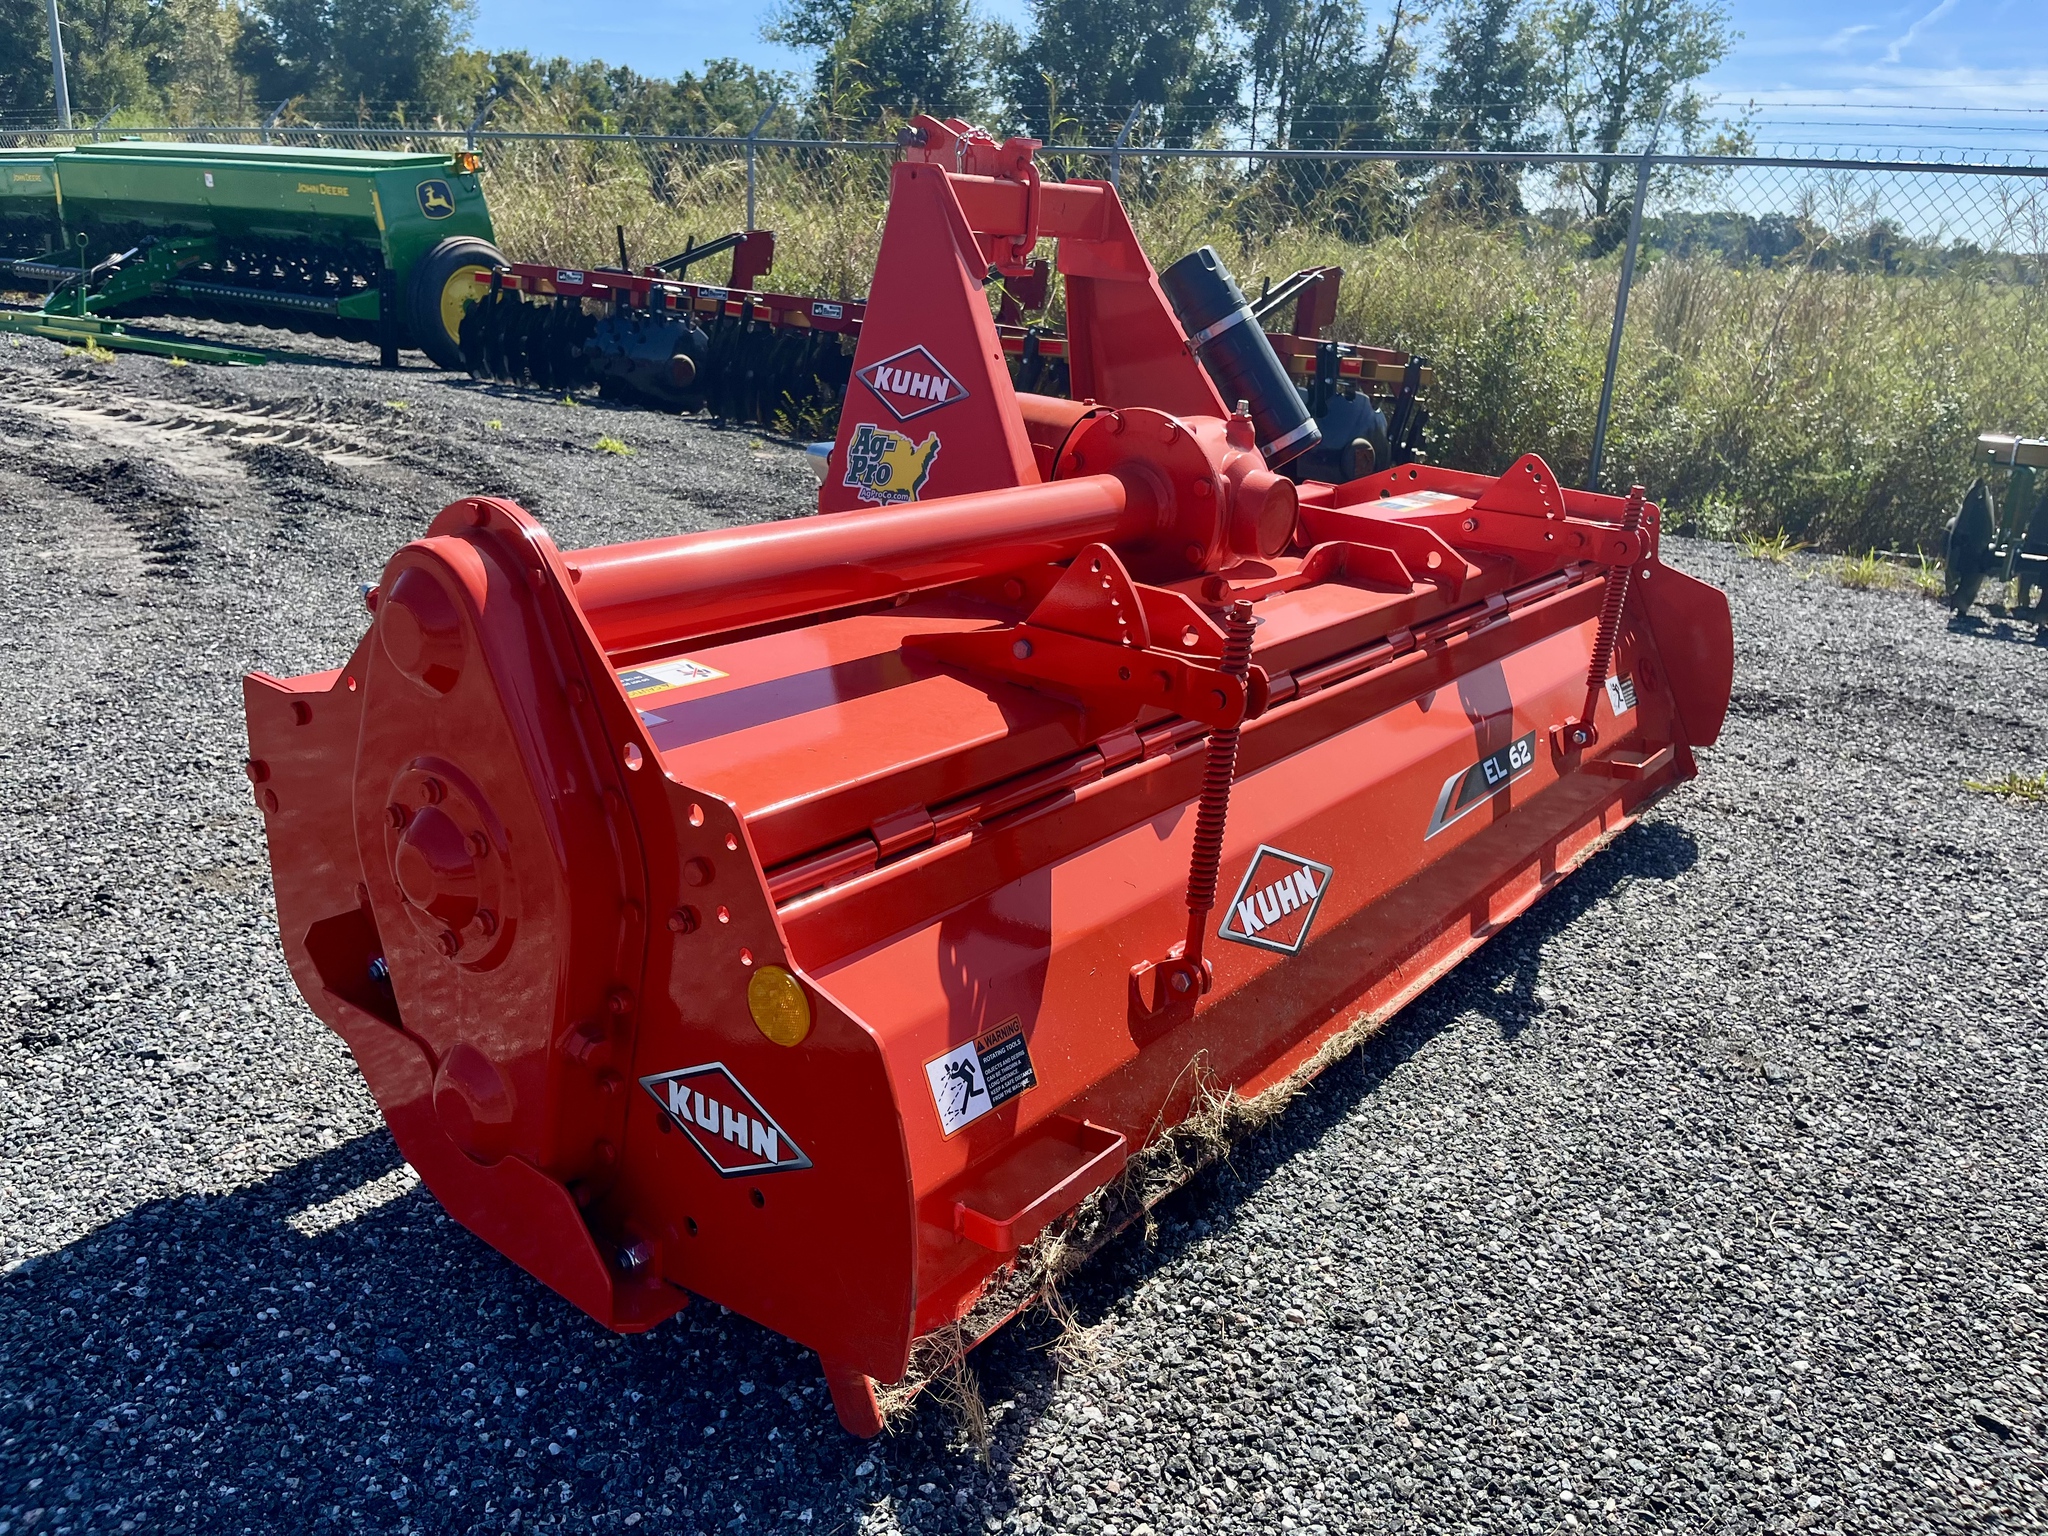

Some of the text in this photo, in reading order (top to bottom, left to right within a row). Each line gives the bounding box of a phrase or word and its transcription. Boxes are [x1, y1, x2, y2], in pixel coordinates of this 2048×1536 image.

[297, 183, 349, 196] JOHN DEERE
[873, 365, 950, 402] KUHN
[851, 427, 896, 463] Ag-
[845, 454, 892, 486] Pro
[860, 488, 909, 500] AgProCo.com
[1482, 740, 1532, 785] EL 62
[1236, 865, 1318, 938] KUHN
[984, 1021, 1019, 1047] WARNING
[983, 1039, 1021, 1063] ROTATING TOOLS
[985, 1050, 1025, 1075] OBJECTS AND DEBRIS
[986, 1074, 996, 1082] CAN
[988, 1079, 1000, 1089] LONG
[990, 1085, 1001, 1095] KEEP
[1004, 1078, 1015, 1087] SAFE
[1014, 1068, 1033, 1081] DISTANCE
[993, 1092, 1004, 1102] FROM
[1004, 1087, 1012, 1095] THE
[668, 1079, 778, 1165] KUHN
